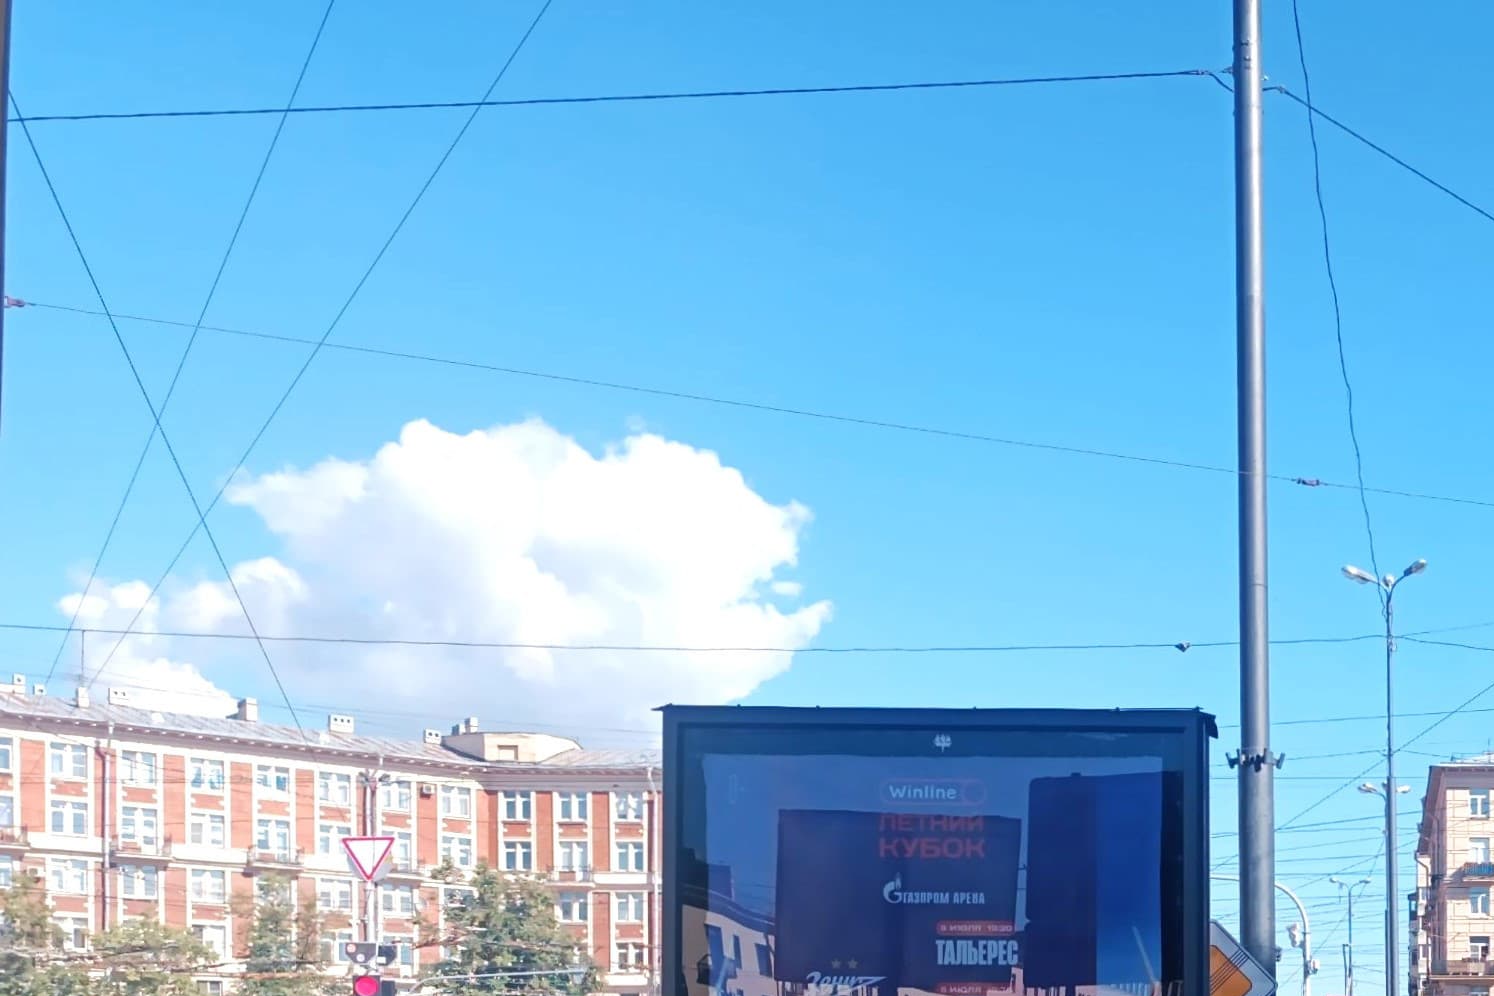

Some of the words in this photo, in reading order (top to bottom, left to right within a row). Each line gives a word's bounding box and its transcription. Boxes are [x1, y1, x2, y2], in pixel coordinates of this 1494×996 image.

[888, 784, 957, 800] Winline
[879, 837, 986, 859] КУБОК
[903, 891, 950, 905] ГАЗПРОМ
[953, 891, 986, 905] АРЕНА
[935, 938, 1019, 967] ТАЛЬЕРЕС
